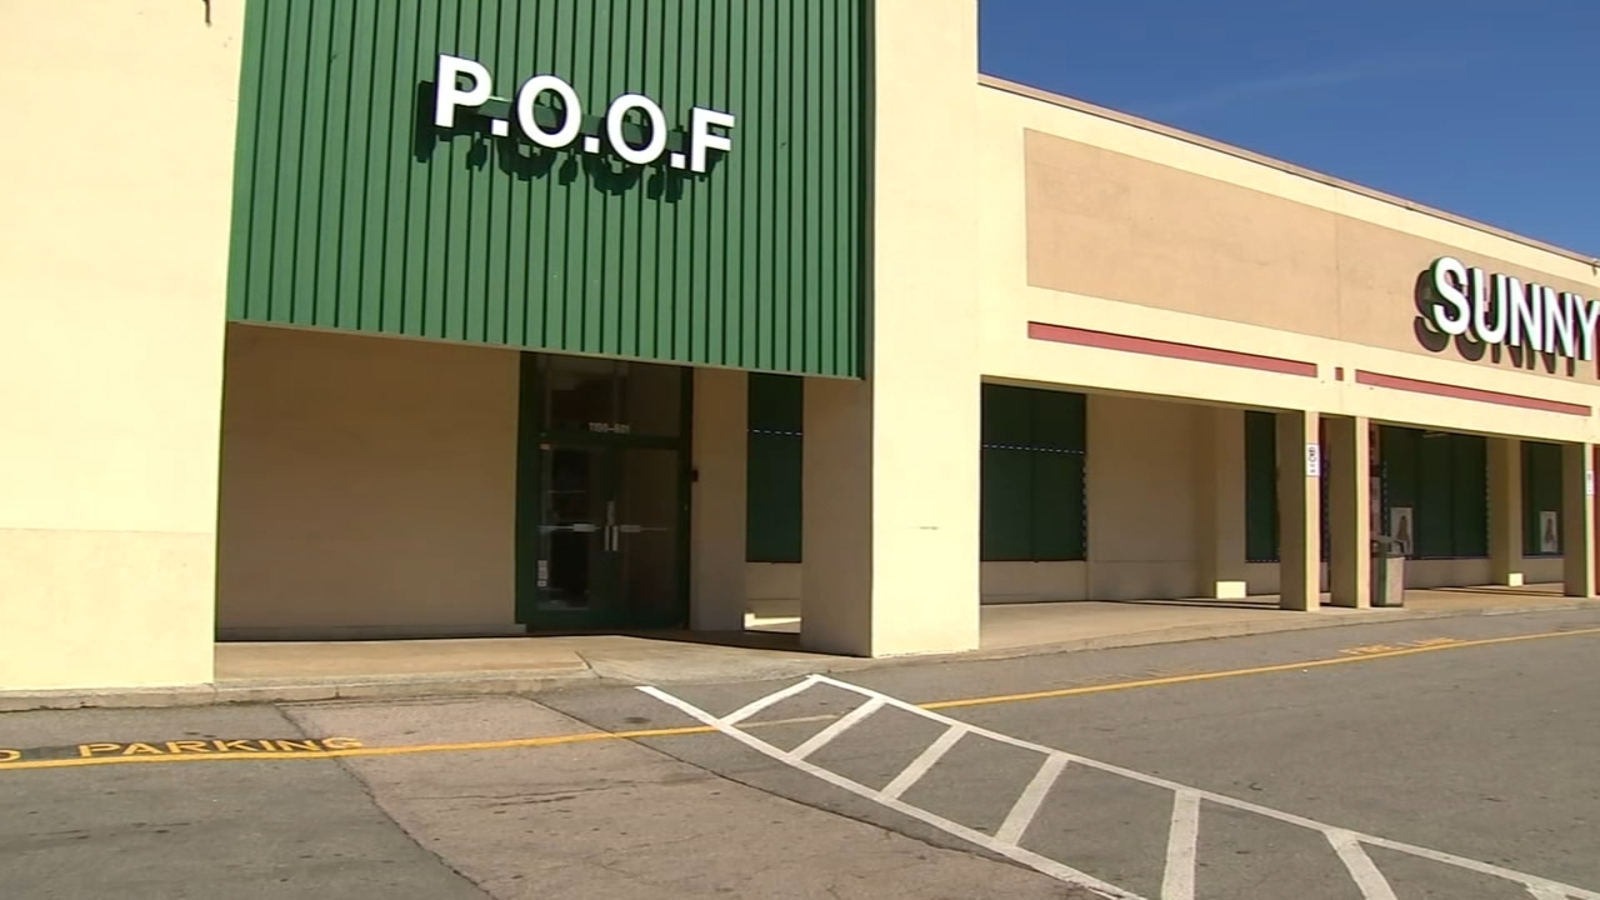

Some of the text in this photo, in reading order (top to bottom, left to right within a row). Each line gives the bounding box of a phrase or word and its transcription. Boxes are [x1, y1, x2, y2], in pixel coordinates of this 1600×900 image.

[435, 54, 735, 173] P.O.O.F
[1432, 256, 1600, 361] SUNNY
[78, 736, 363, 757] PARKING
